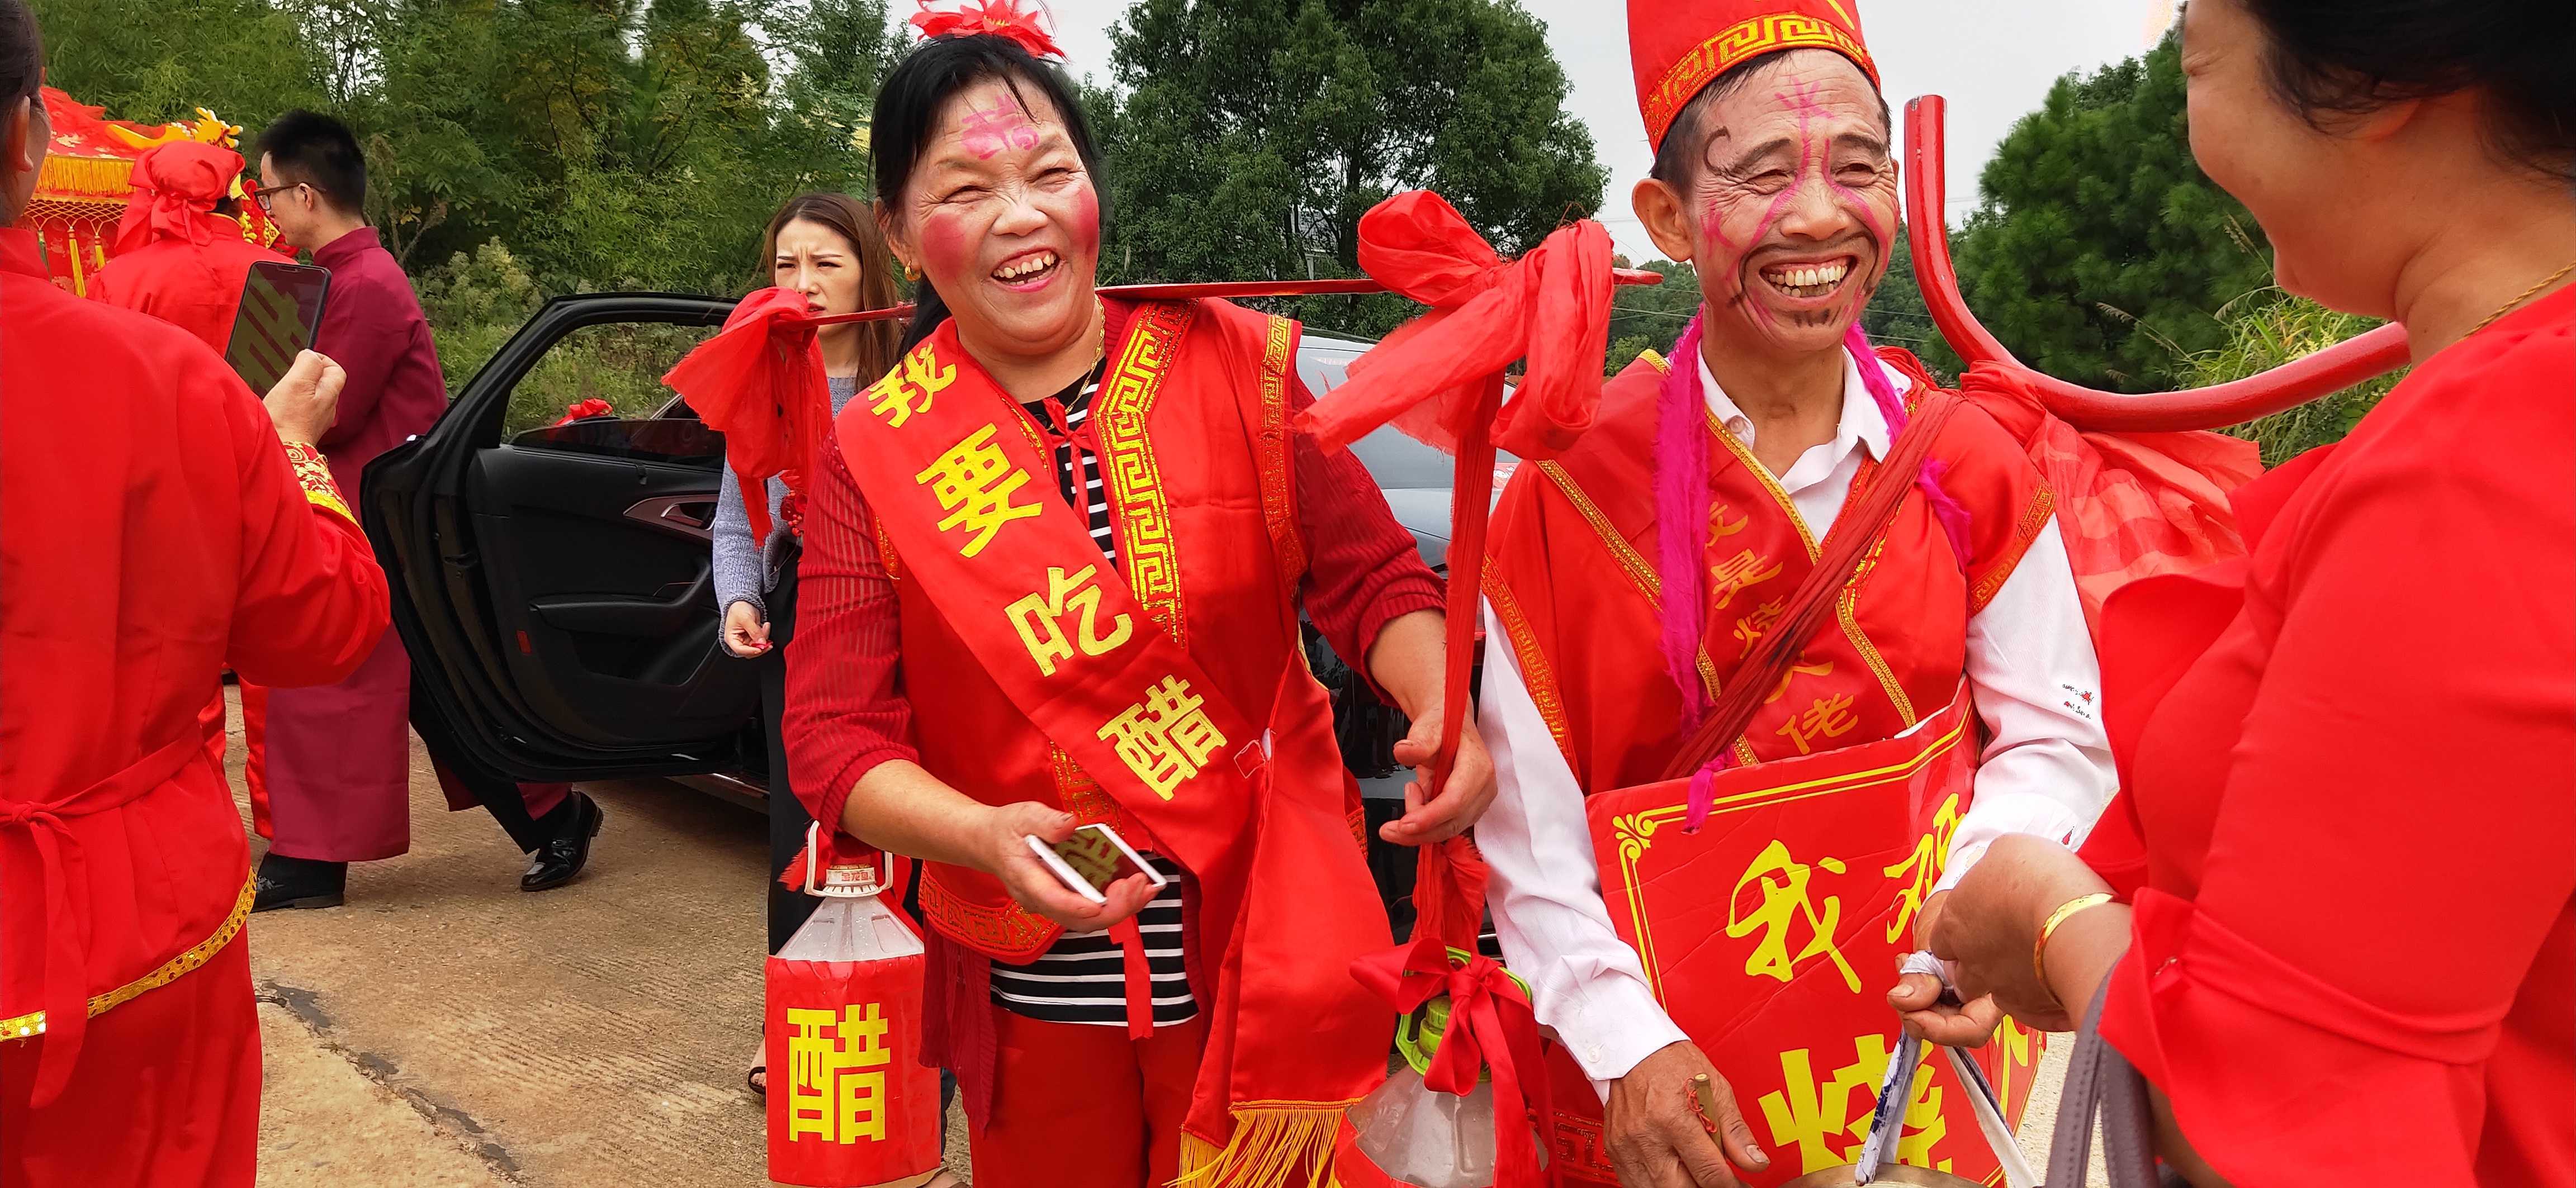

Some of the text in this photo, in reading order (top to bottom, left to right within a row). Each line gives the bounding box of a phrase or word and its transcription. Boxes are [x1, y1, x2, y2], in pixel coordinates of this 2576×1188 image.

[869, 342, 1228, 801] 我要吃醋
[787, 1002, 890, 1144] 醋
